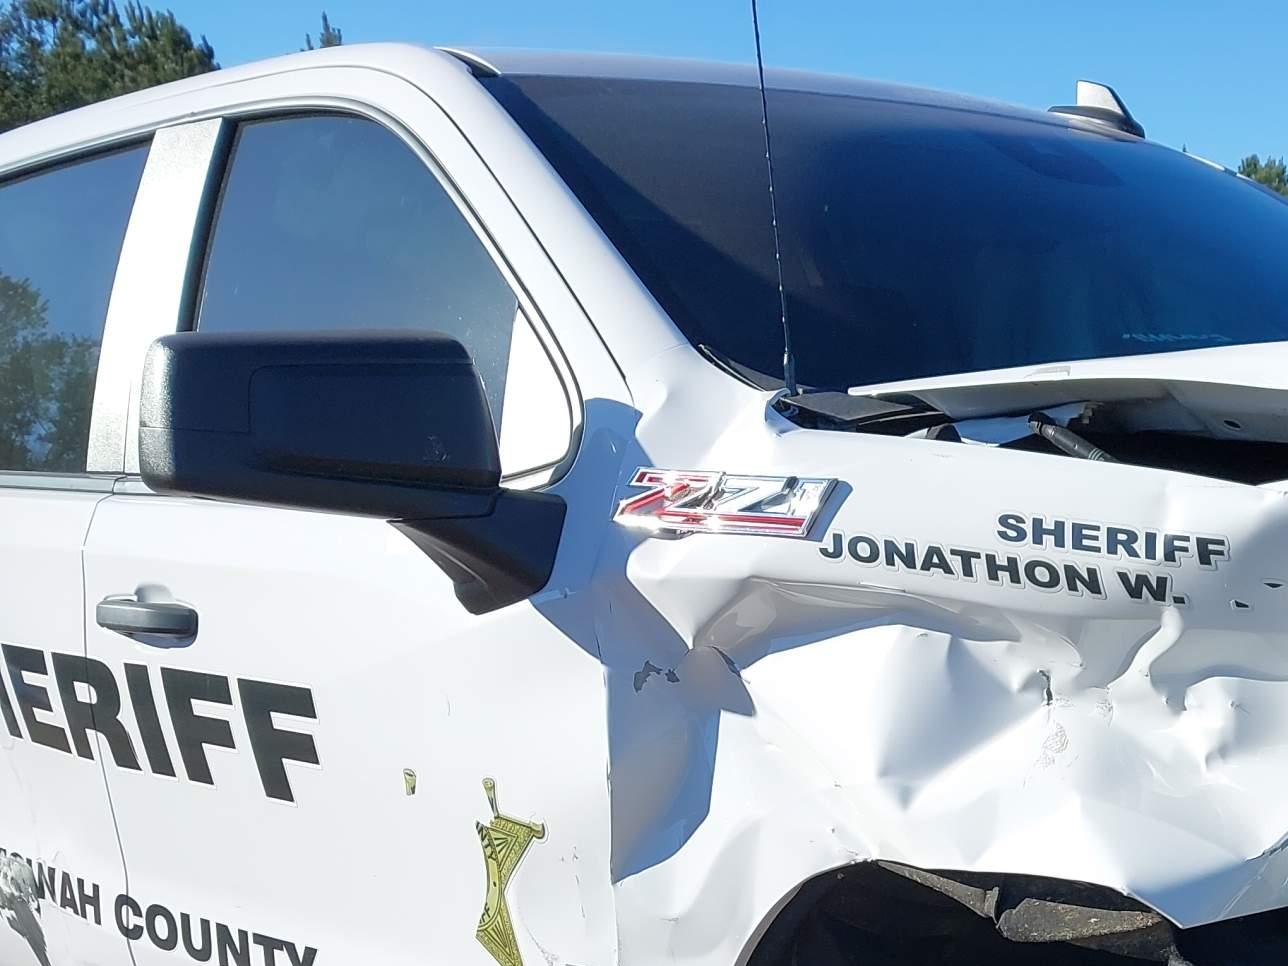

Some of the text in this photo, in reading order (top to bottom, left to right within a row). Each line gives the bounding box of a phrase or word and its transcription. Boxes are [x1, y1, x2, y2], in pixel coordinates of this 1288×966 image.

[819, 532, 1103, 596] JONATHON
[1116, 570, 1186, 604] W.
[997, 513, 1226, 566] SHERIFF
[0, 847, 102, 927] WAH
